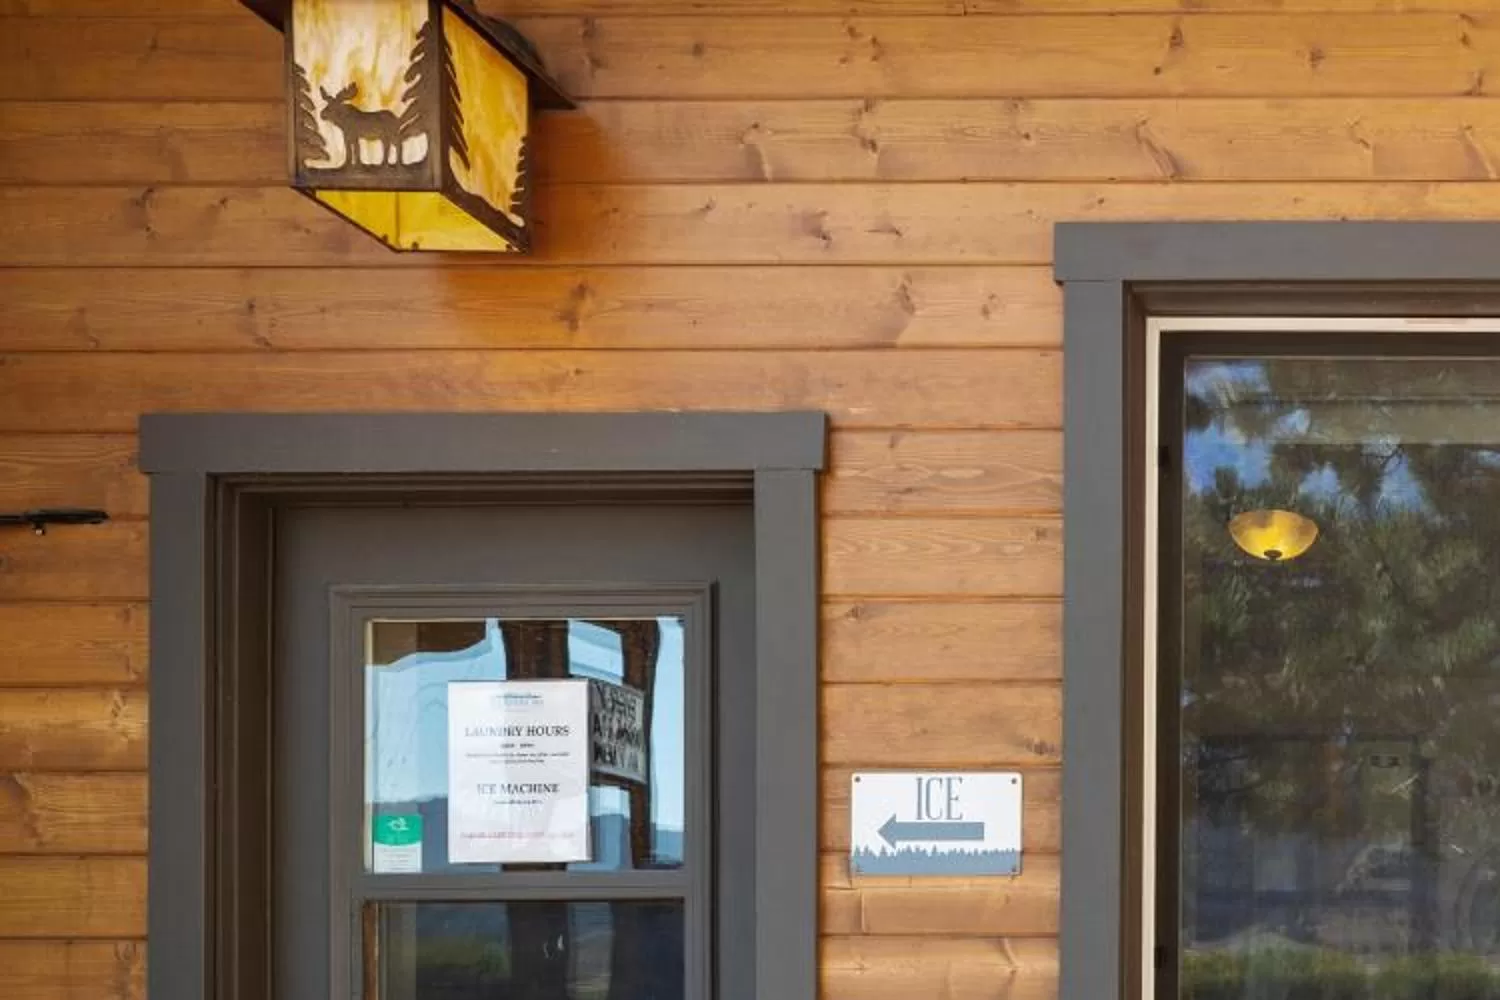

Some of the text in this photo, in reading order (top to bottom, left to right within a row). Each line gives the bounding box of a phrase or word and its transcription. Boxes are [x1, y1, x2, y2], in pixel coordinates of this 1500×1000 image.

[464, 725, 570, 737] LAUNDRY HOURS
[477, 783, 560, 795] ICE MACHINE
[916, 776, 963, 821] ICE
